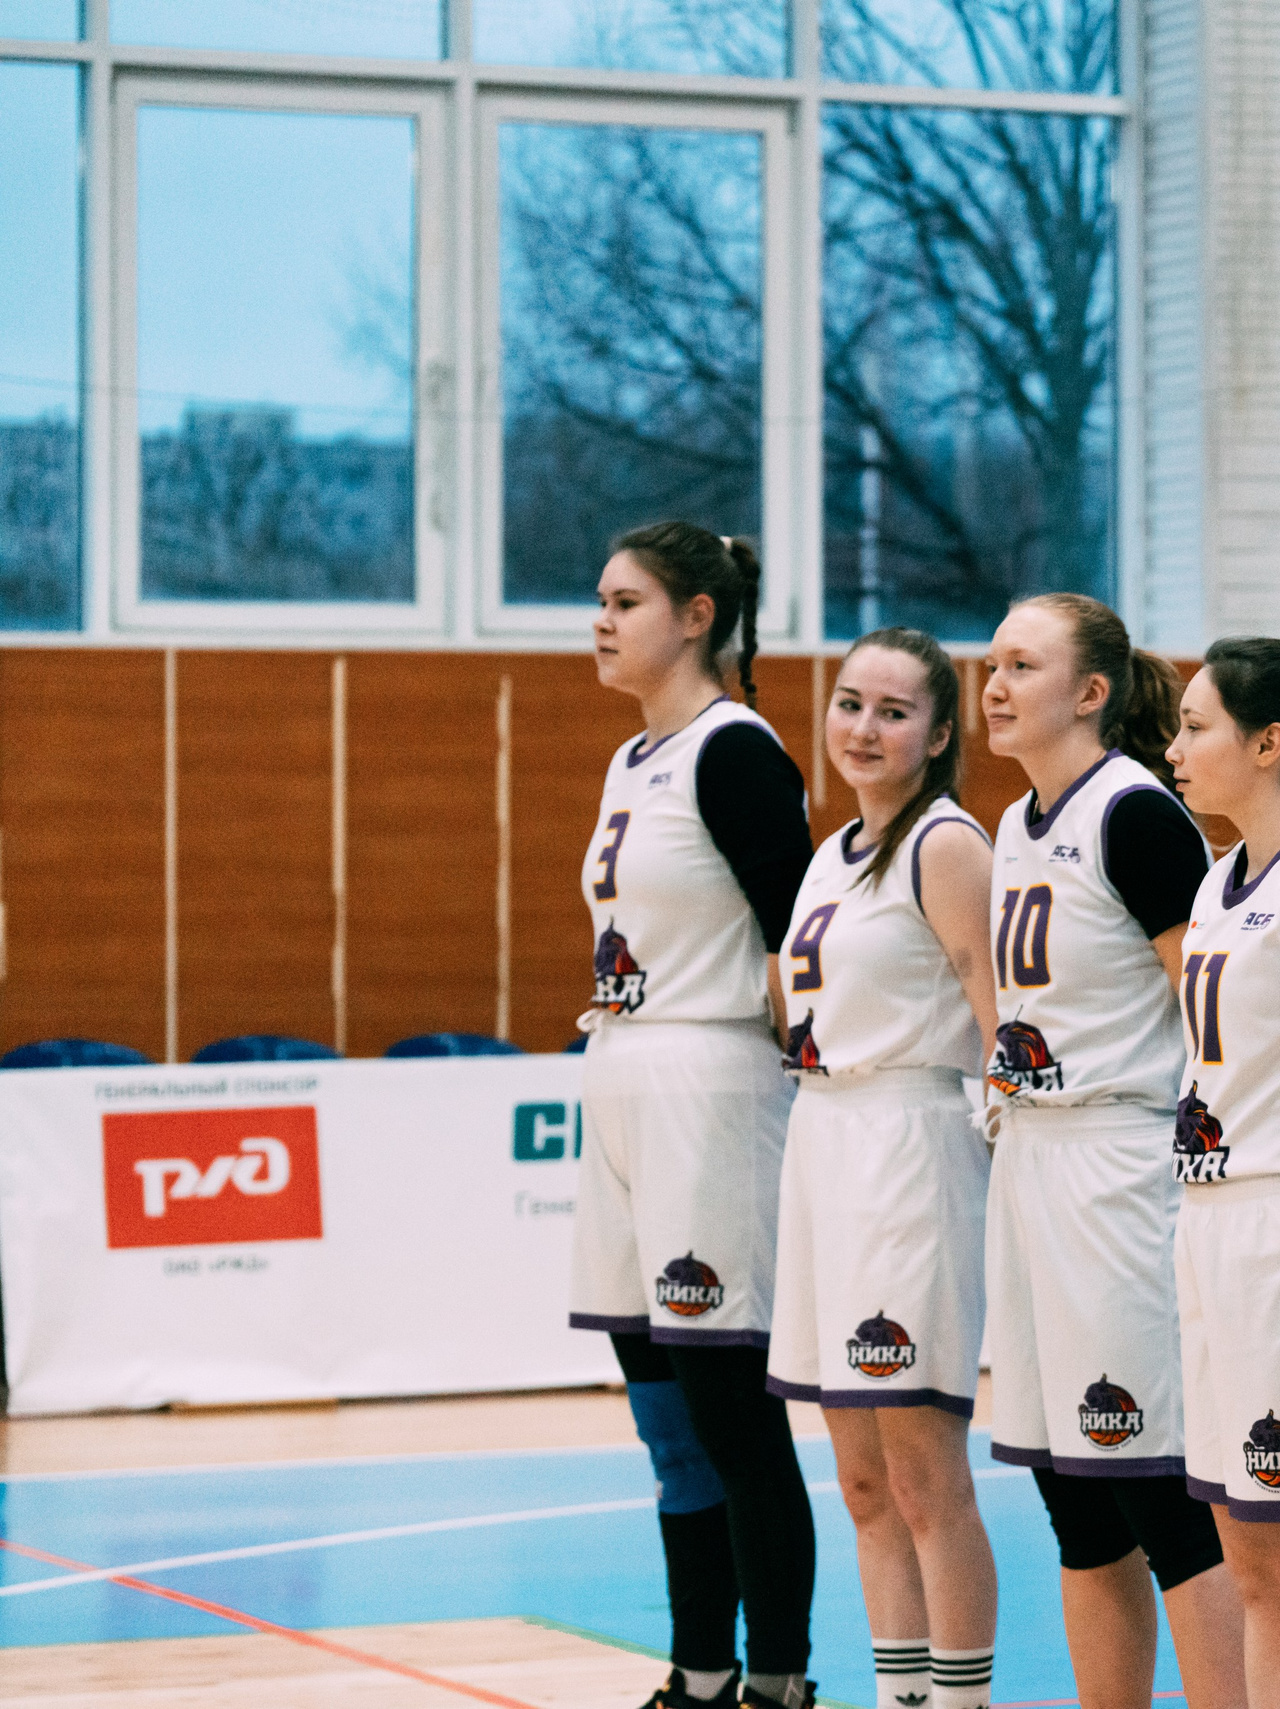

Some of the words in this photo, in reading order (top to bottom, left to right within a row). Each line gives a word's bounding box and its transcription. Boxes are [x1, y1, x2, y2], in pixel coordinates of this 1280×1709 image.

[593, 809, 631, 902] 3
[790, 901, 841, 994] 9
[996, 882, 1053, 991] 10
[1183, 951, 1230, 1065] 11
[657, 1284, 720, 1305] НИКА
[850, 1345, 913, 1366] НИКА
[1081, 1412, 1141, 1434] НИКА
